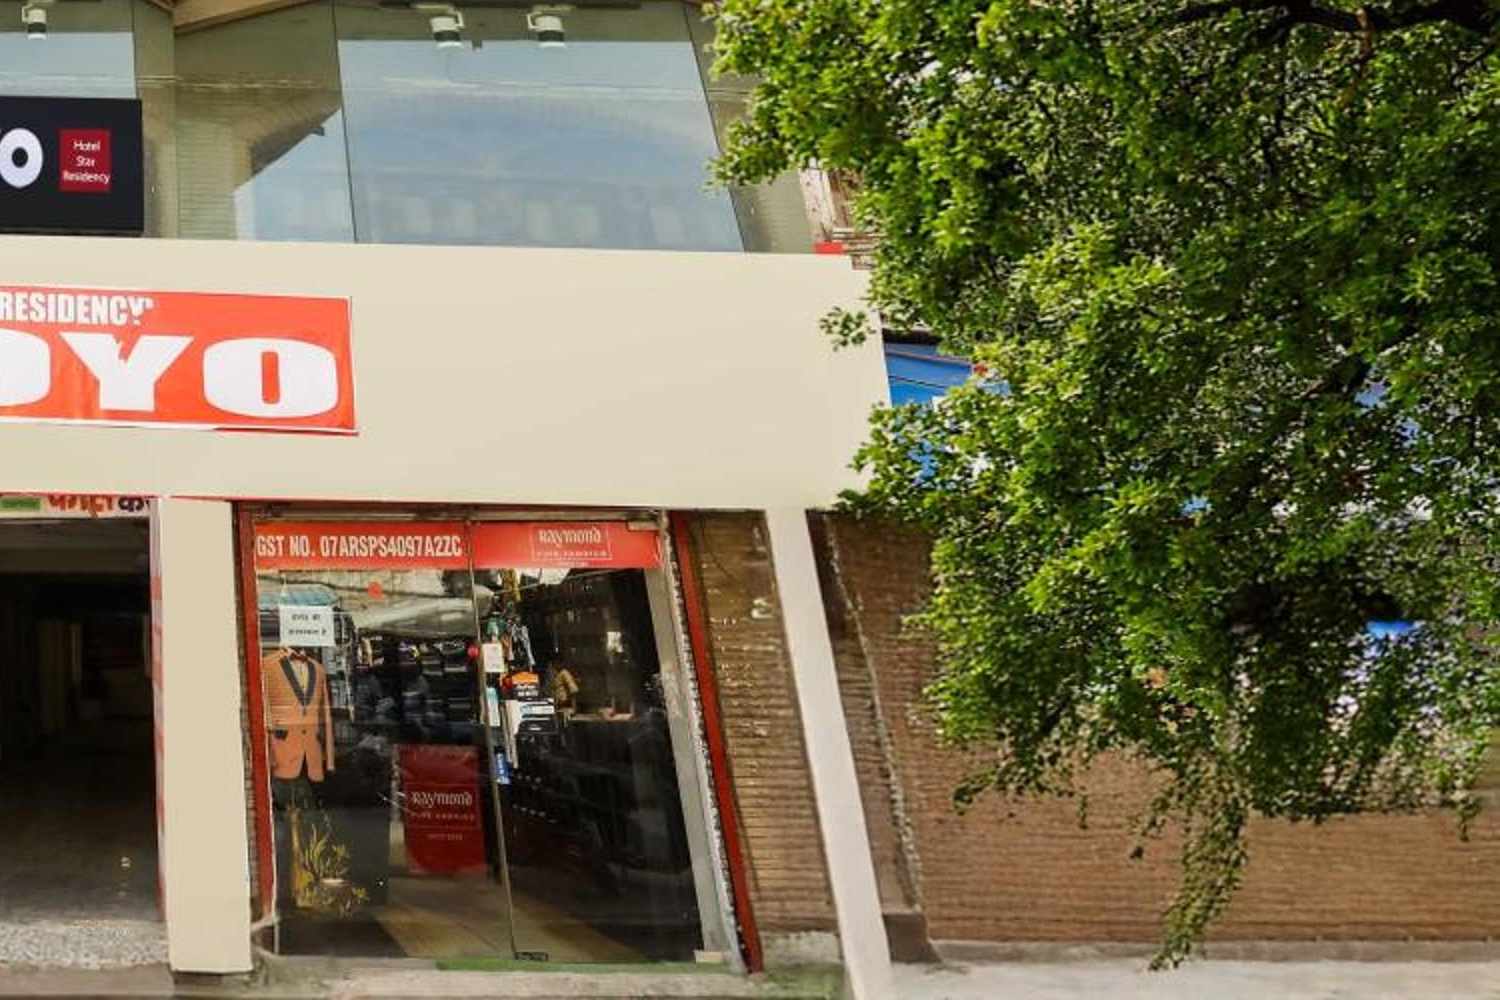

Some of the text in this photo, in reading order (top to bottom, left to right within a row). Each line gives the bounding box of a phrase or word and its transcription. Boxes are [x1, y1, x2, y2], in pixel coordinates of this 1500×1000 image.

[74, 140, 101, 151] Hotel
[76, 156, 96, 167] Star
[63, 171, 111, 185] Residency
[538, 526, 601, 548] Raymond
[257, 536, 284, 557] GST
[290, 536, 315, 557] NO.
